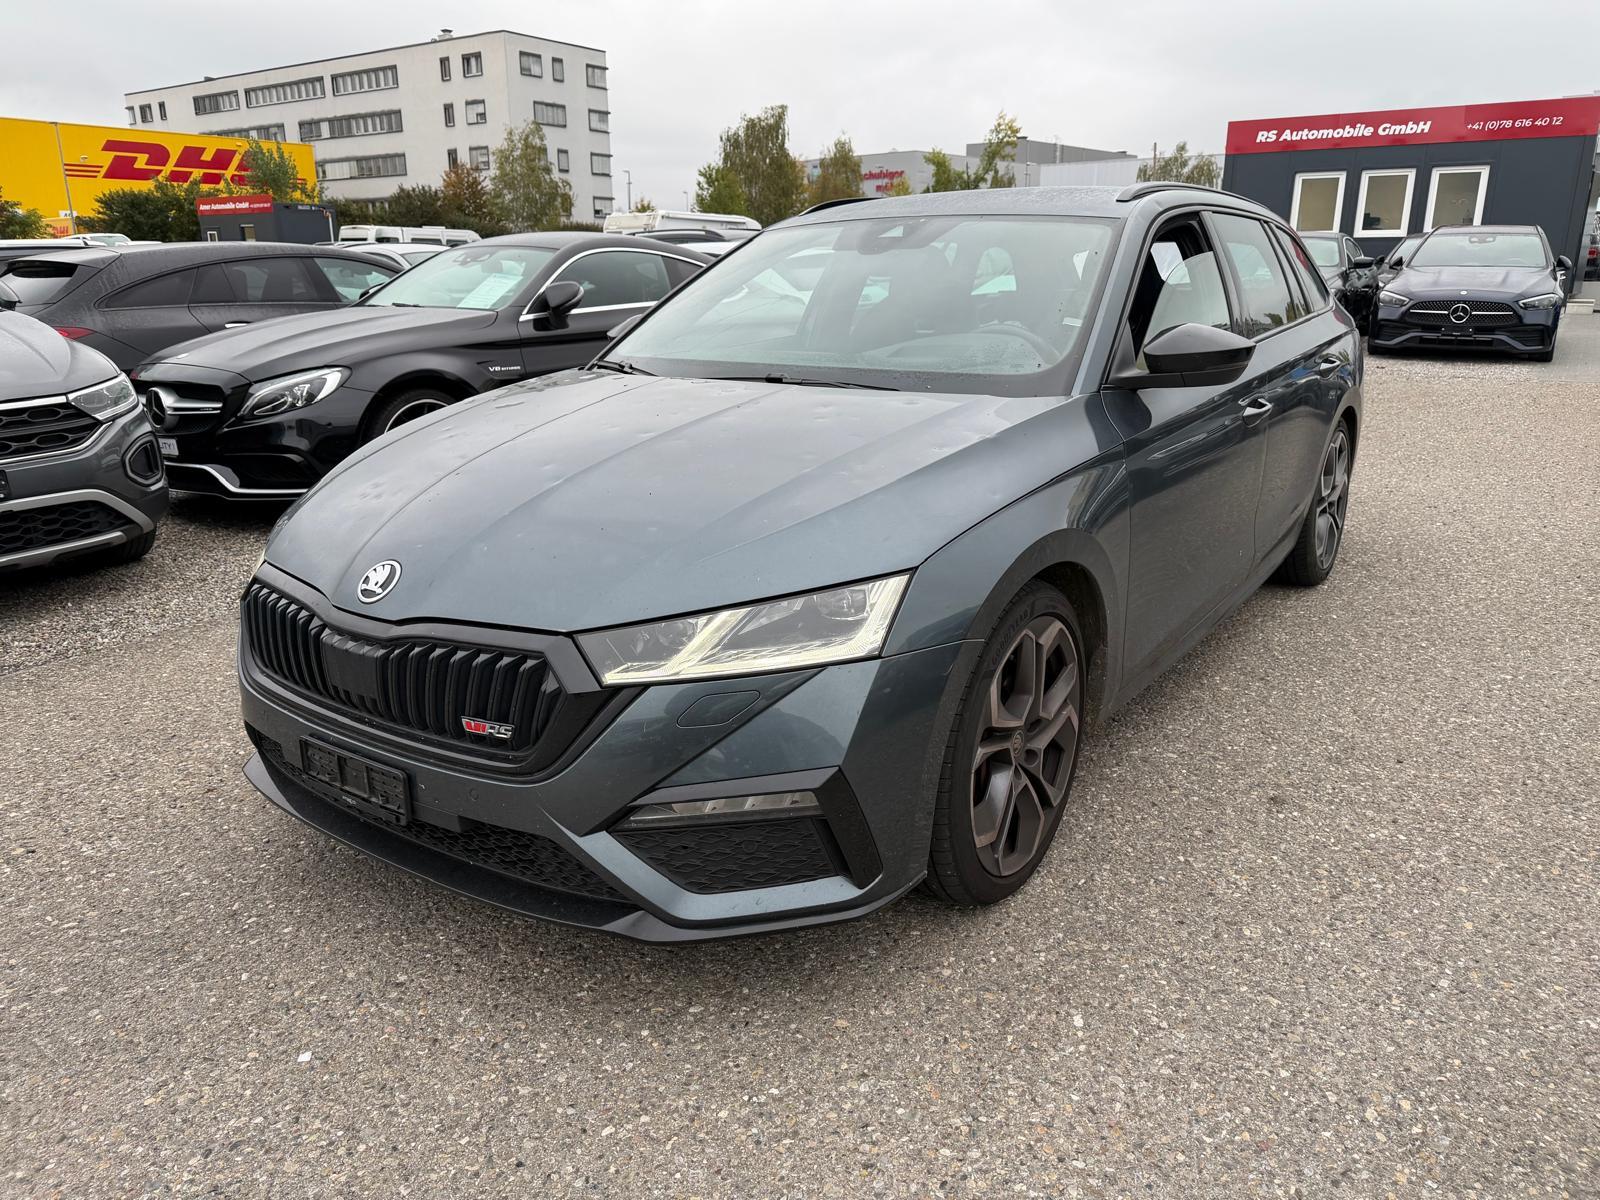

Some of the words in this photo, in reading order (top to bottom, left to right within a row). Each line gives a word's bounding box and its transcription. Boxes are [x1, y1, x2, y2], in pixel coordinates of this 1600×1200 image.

[1256, 130, 1278, 143] RS
[1278, 124, 1374, 142] Automobile
[1377, 120, 1432, 135] GmbH
[1466, 121, 1483, 130] +41
[1485, 120, 1513, 131] (0)78
[1514, 118, 1532, 128] 616
[1534, 117, 1550, 126] 40
[1551, 116, 1564, 125] 12
[864, 169, 905, 181] chubiger
